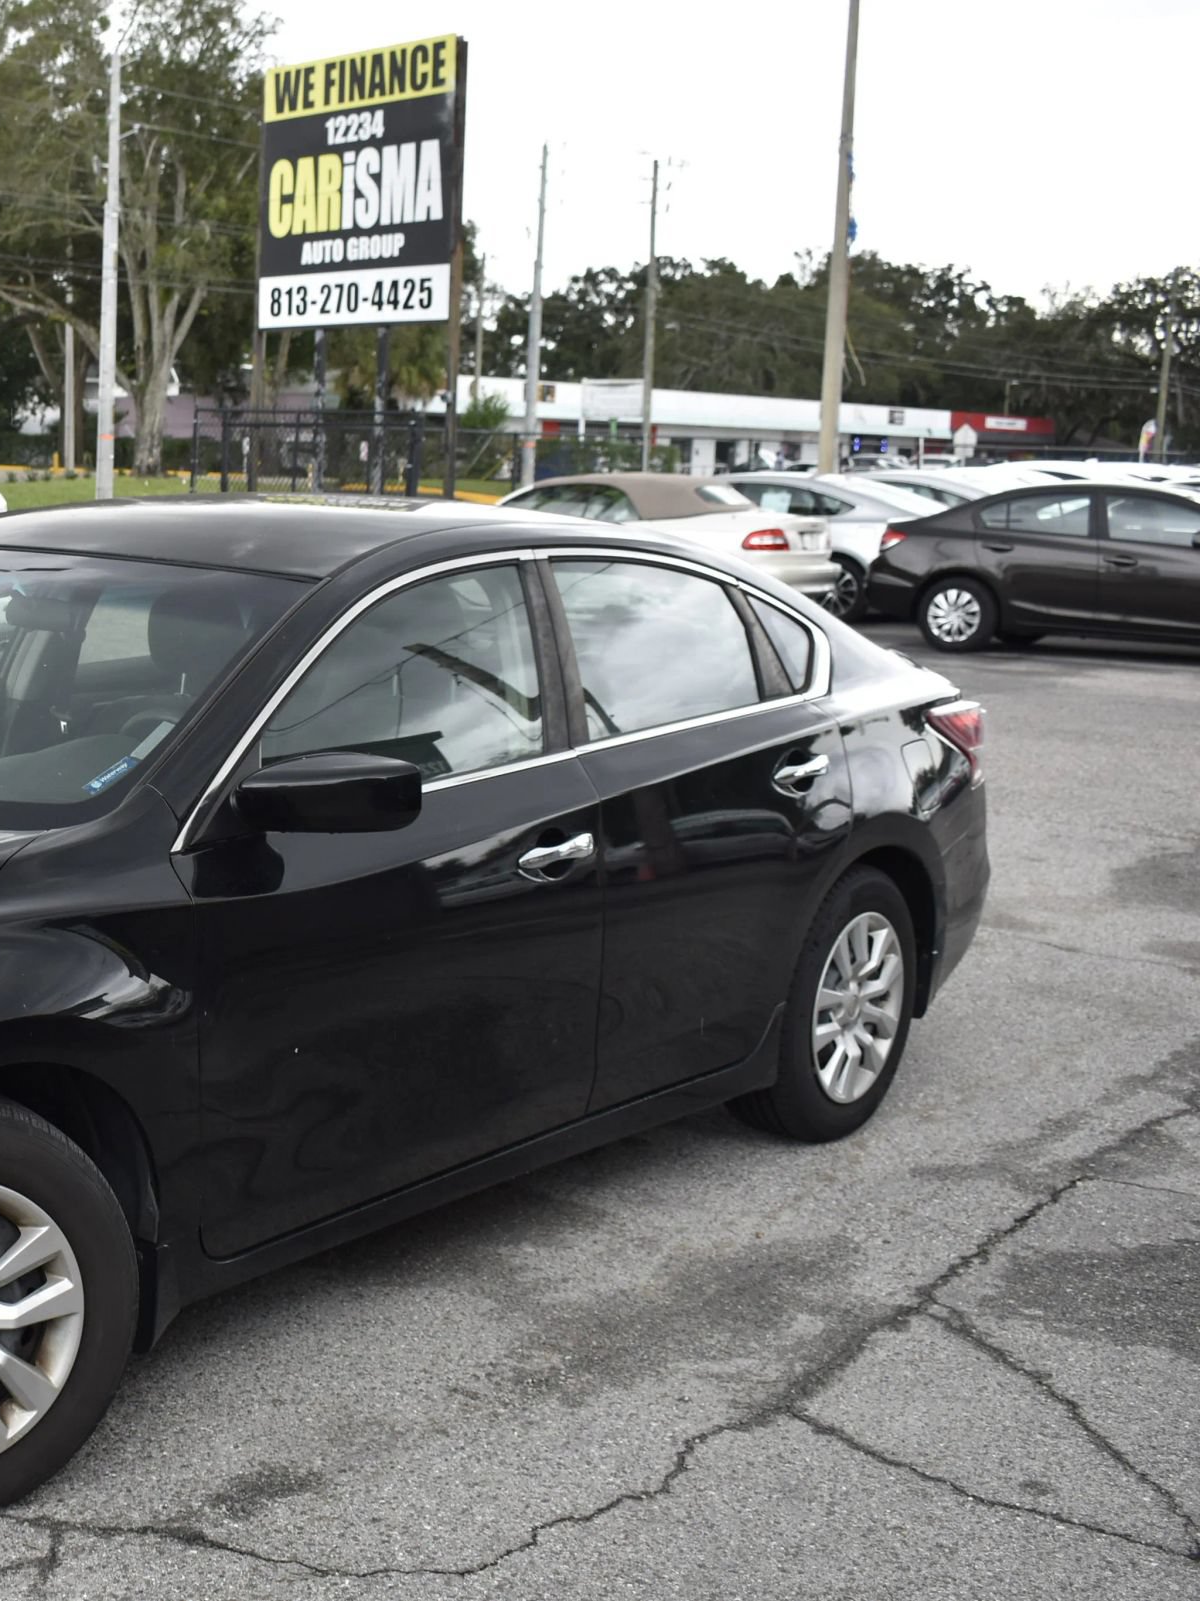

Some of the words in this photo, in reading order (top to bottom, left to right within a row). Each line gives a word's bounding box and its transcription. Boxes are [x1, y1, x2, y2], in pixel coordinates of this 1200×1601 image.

[275, 67, 314, 114] WE
[324, 41, 447, 106] FINANCE
[325, 109, 385, 146] 12234
[301, 239, 344, 266] AUTO
[347, 232, 405, 262] GROUP
[270, 278, 433, 318] 813-270-4425
